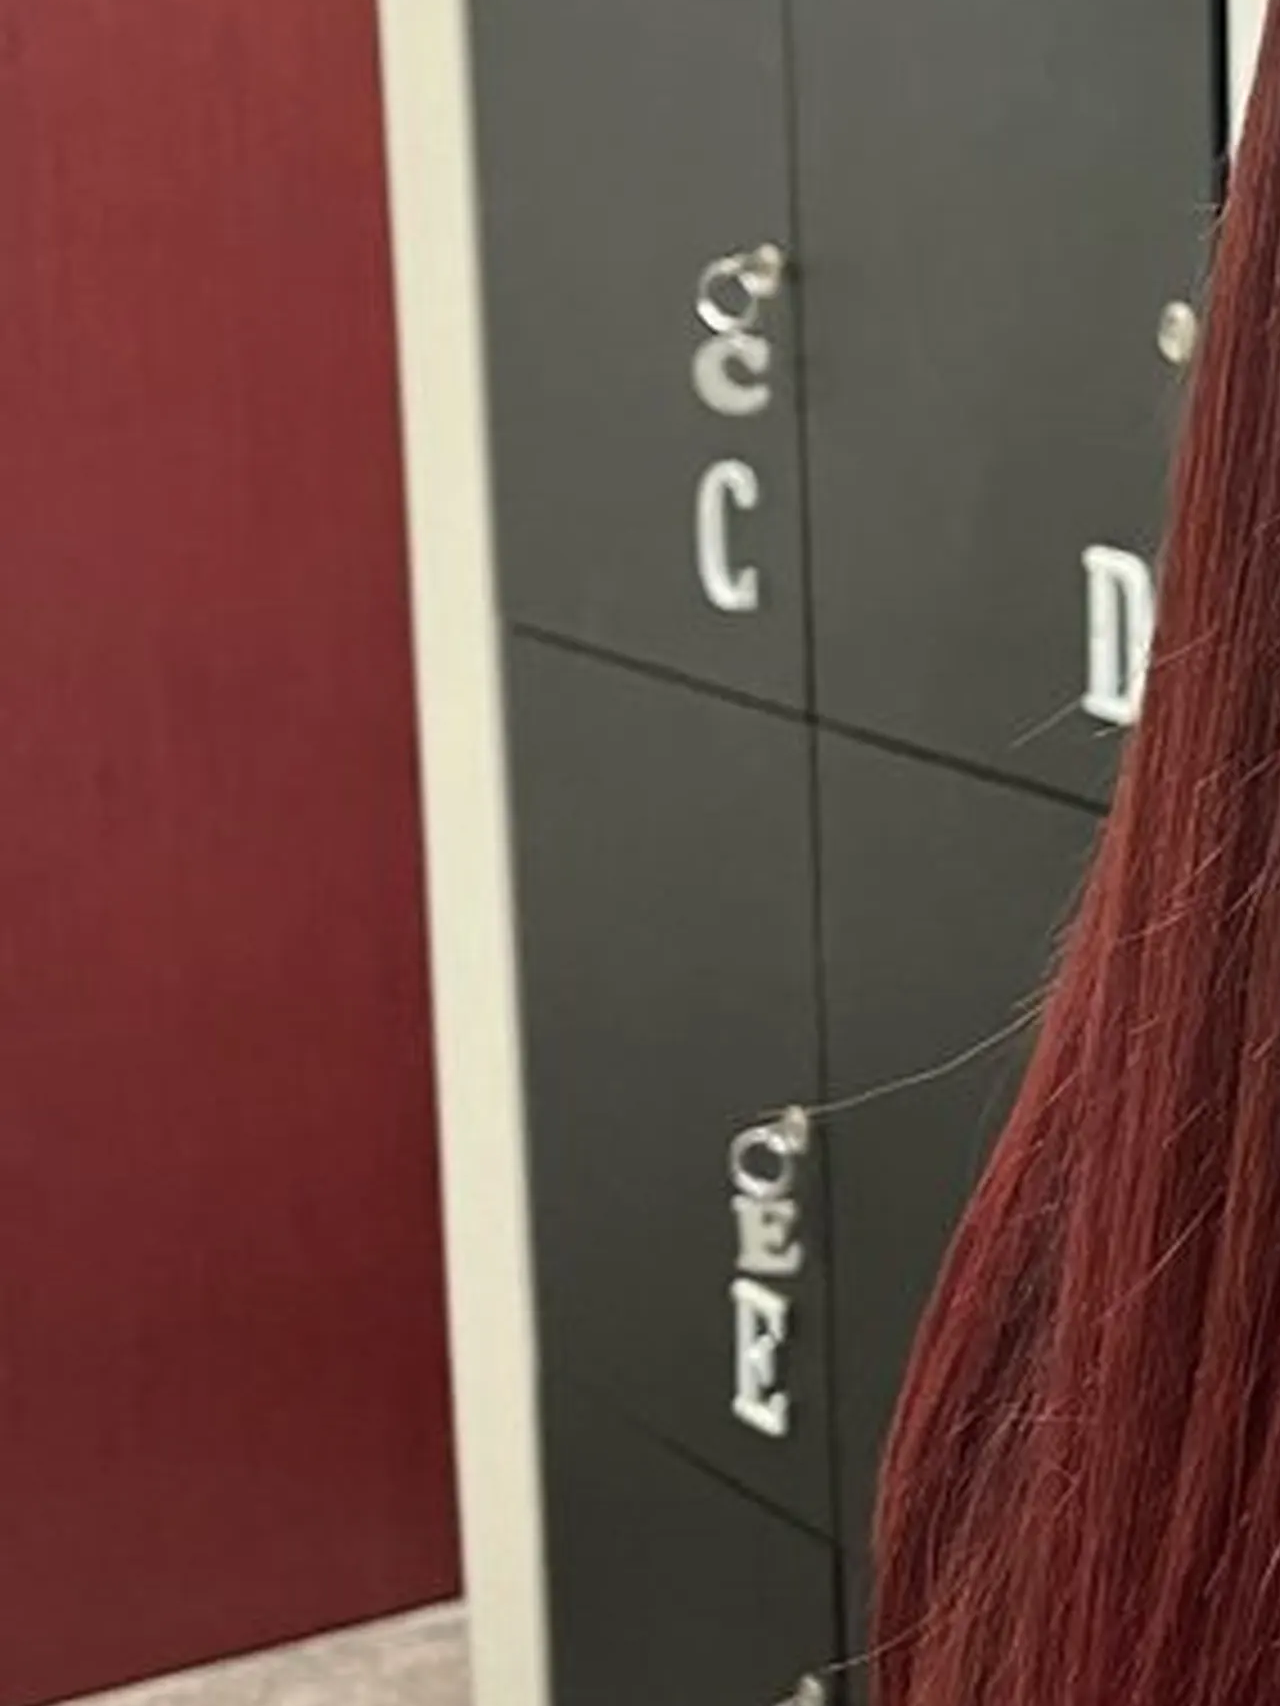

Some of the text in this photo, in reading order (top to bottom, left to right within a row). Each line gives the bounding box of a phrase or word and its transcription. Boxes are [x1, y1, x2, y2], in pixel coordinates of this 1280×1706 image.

[695, 458, 760, 612] C
[1081, 542, 1156, 727] D
[729, 1276, 789, 1437] E
